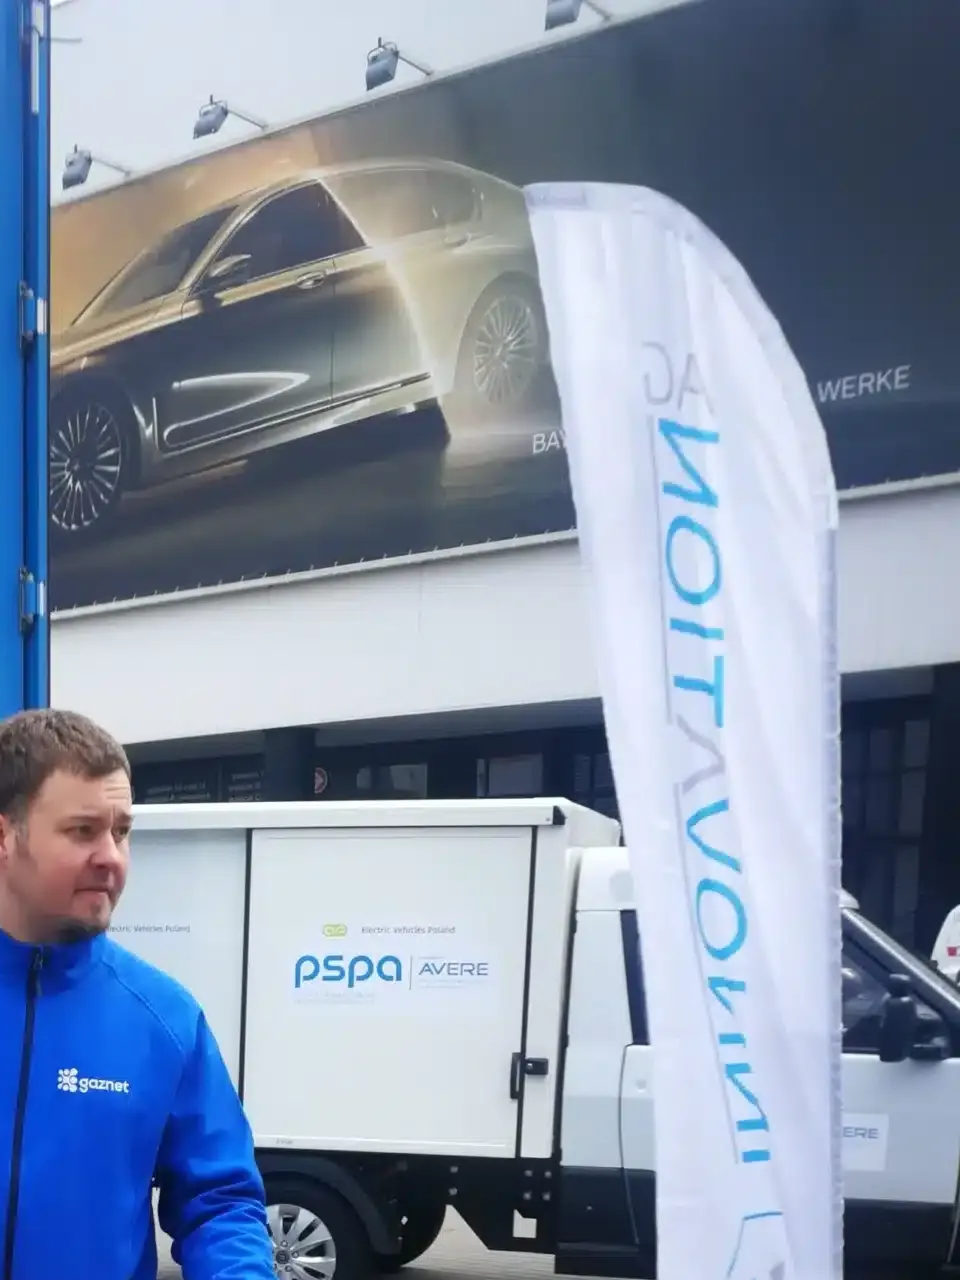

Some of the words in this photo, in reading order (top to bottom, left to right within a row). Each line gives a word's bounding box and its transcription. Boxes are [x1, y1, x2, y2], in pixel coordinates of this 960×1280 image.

[532, 430, 566, 454] BA
[817, 364, 912, 402] WERKE
[361, 926, 389, 935] Electric
[393, 926, 426, 935] Vehicles
[428, 926, 456, 935] Poland
[294, 955, 402, 988] pspa
[418, 962, 489, 977] AVERE
[79, 1078, 130, 1094] gaznet
